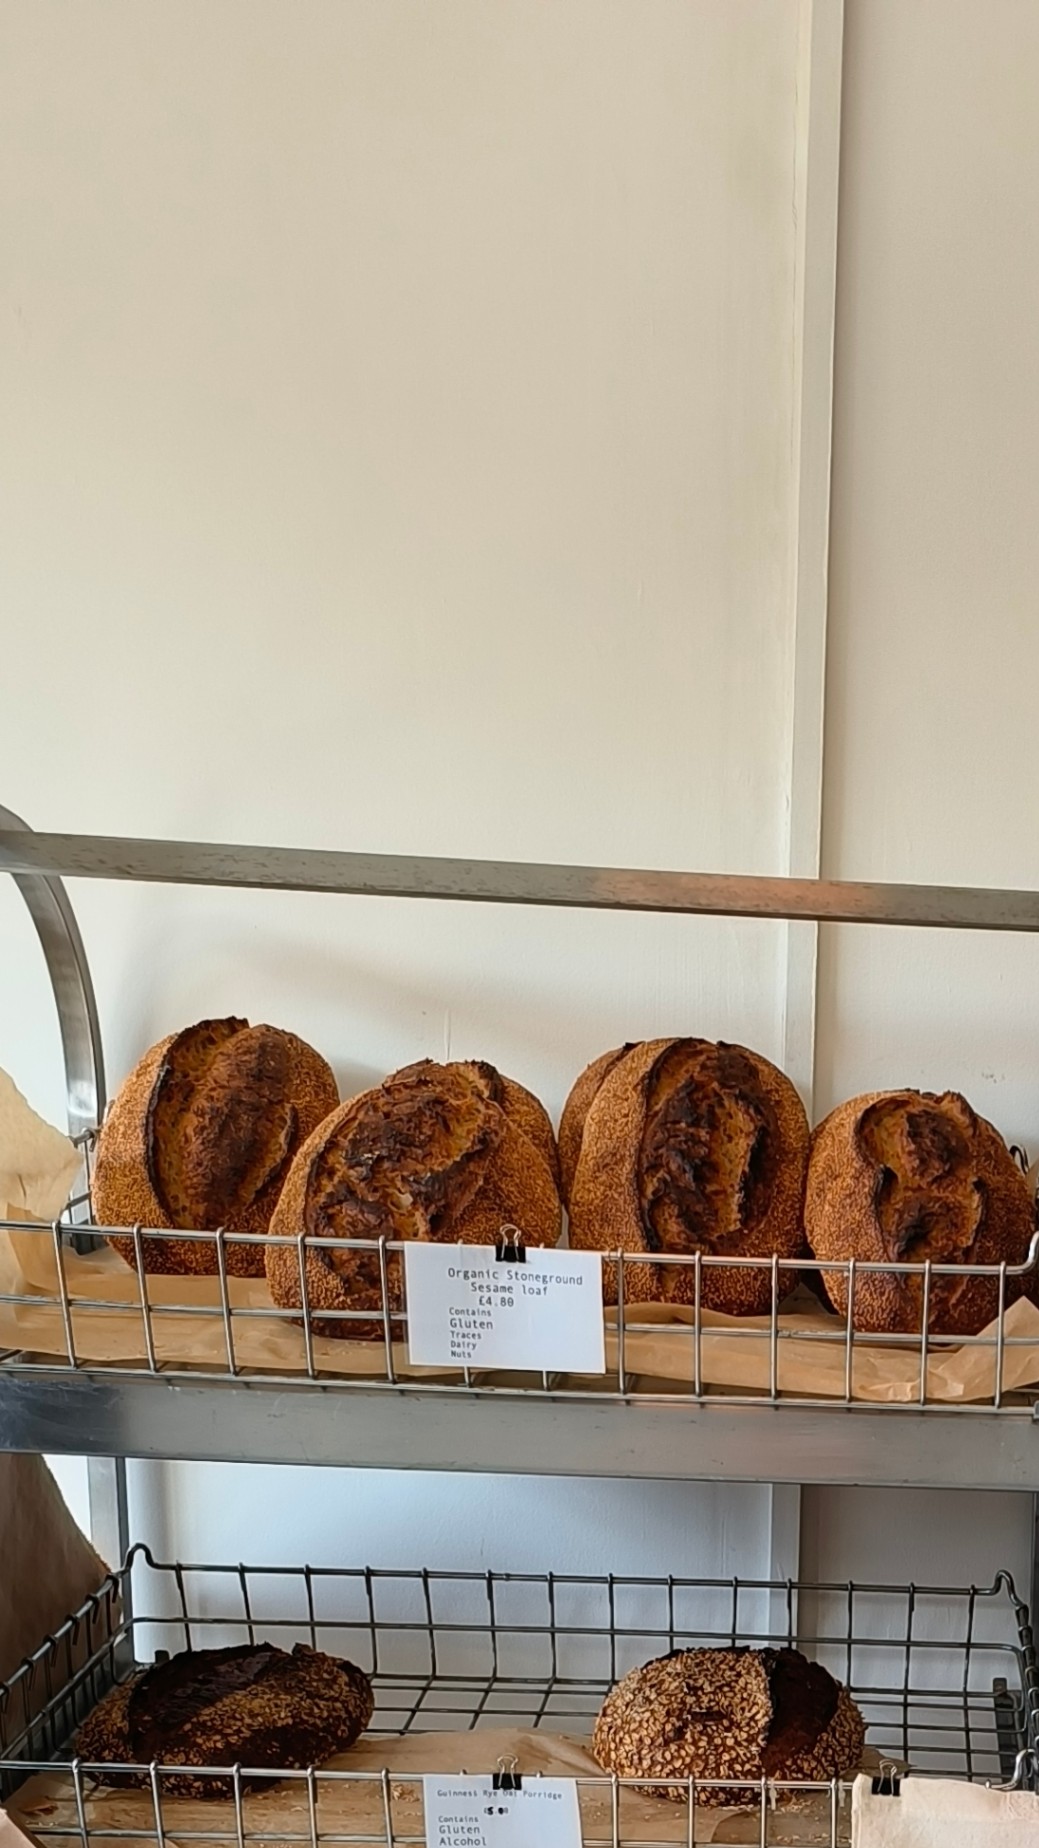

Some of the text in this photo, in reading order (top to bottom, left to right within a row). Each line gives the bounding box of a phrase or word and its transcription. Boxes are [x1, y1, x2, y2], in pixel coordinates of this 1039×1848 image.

[448, 1267, 583, 1285] Organic Stoneground
[471, 1282, 548, 1296] Sesame loaf
[479, 1296, 514, 1307] £4.80
[449, 1308, 492, 1317] Contains
[450, 1319, 493, 1330] Gluten
[450, 1331, 482, 1340] Traces
[451, 1341, 477, 1350] Dairy
[483, 1790, 497, 1798] Rye
[523, 1791, 562, 1799] Porridge
[439, 1825, 480, 1834] Gluten
[439, 1837, 486, 1846] Alcohol
